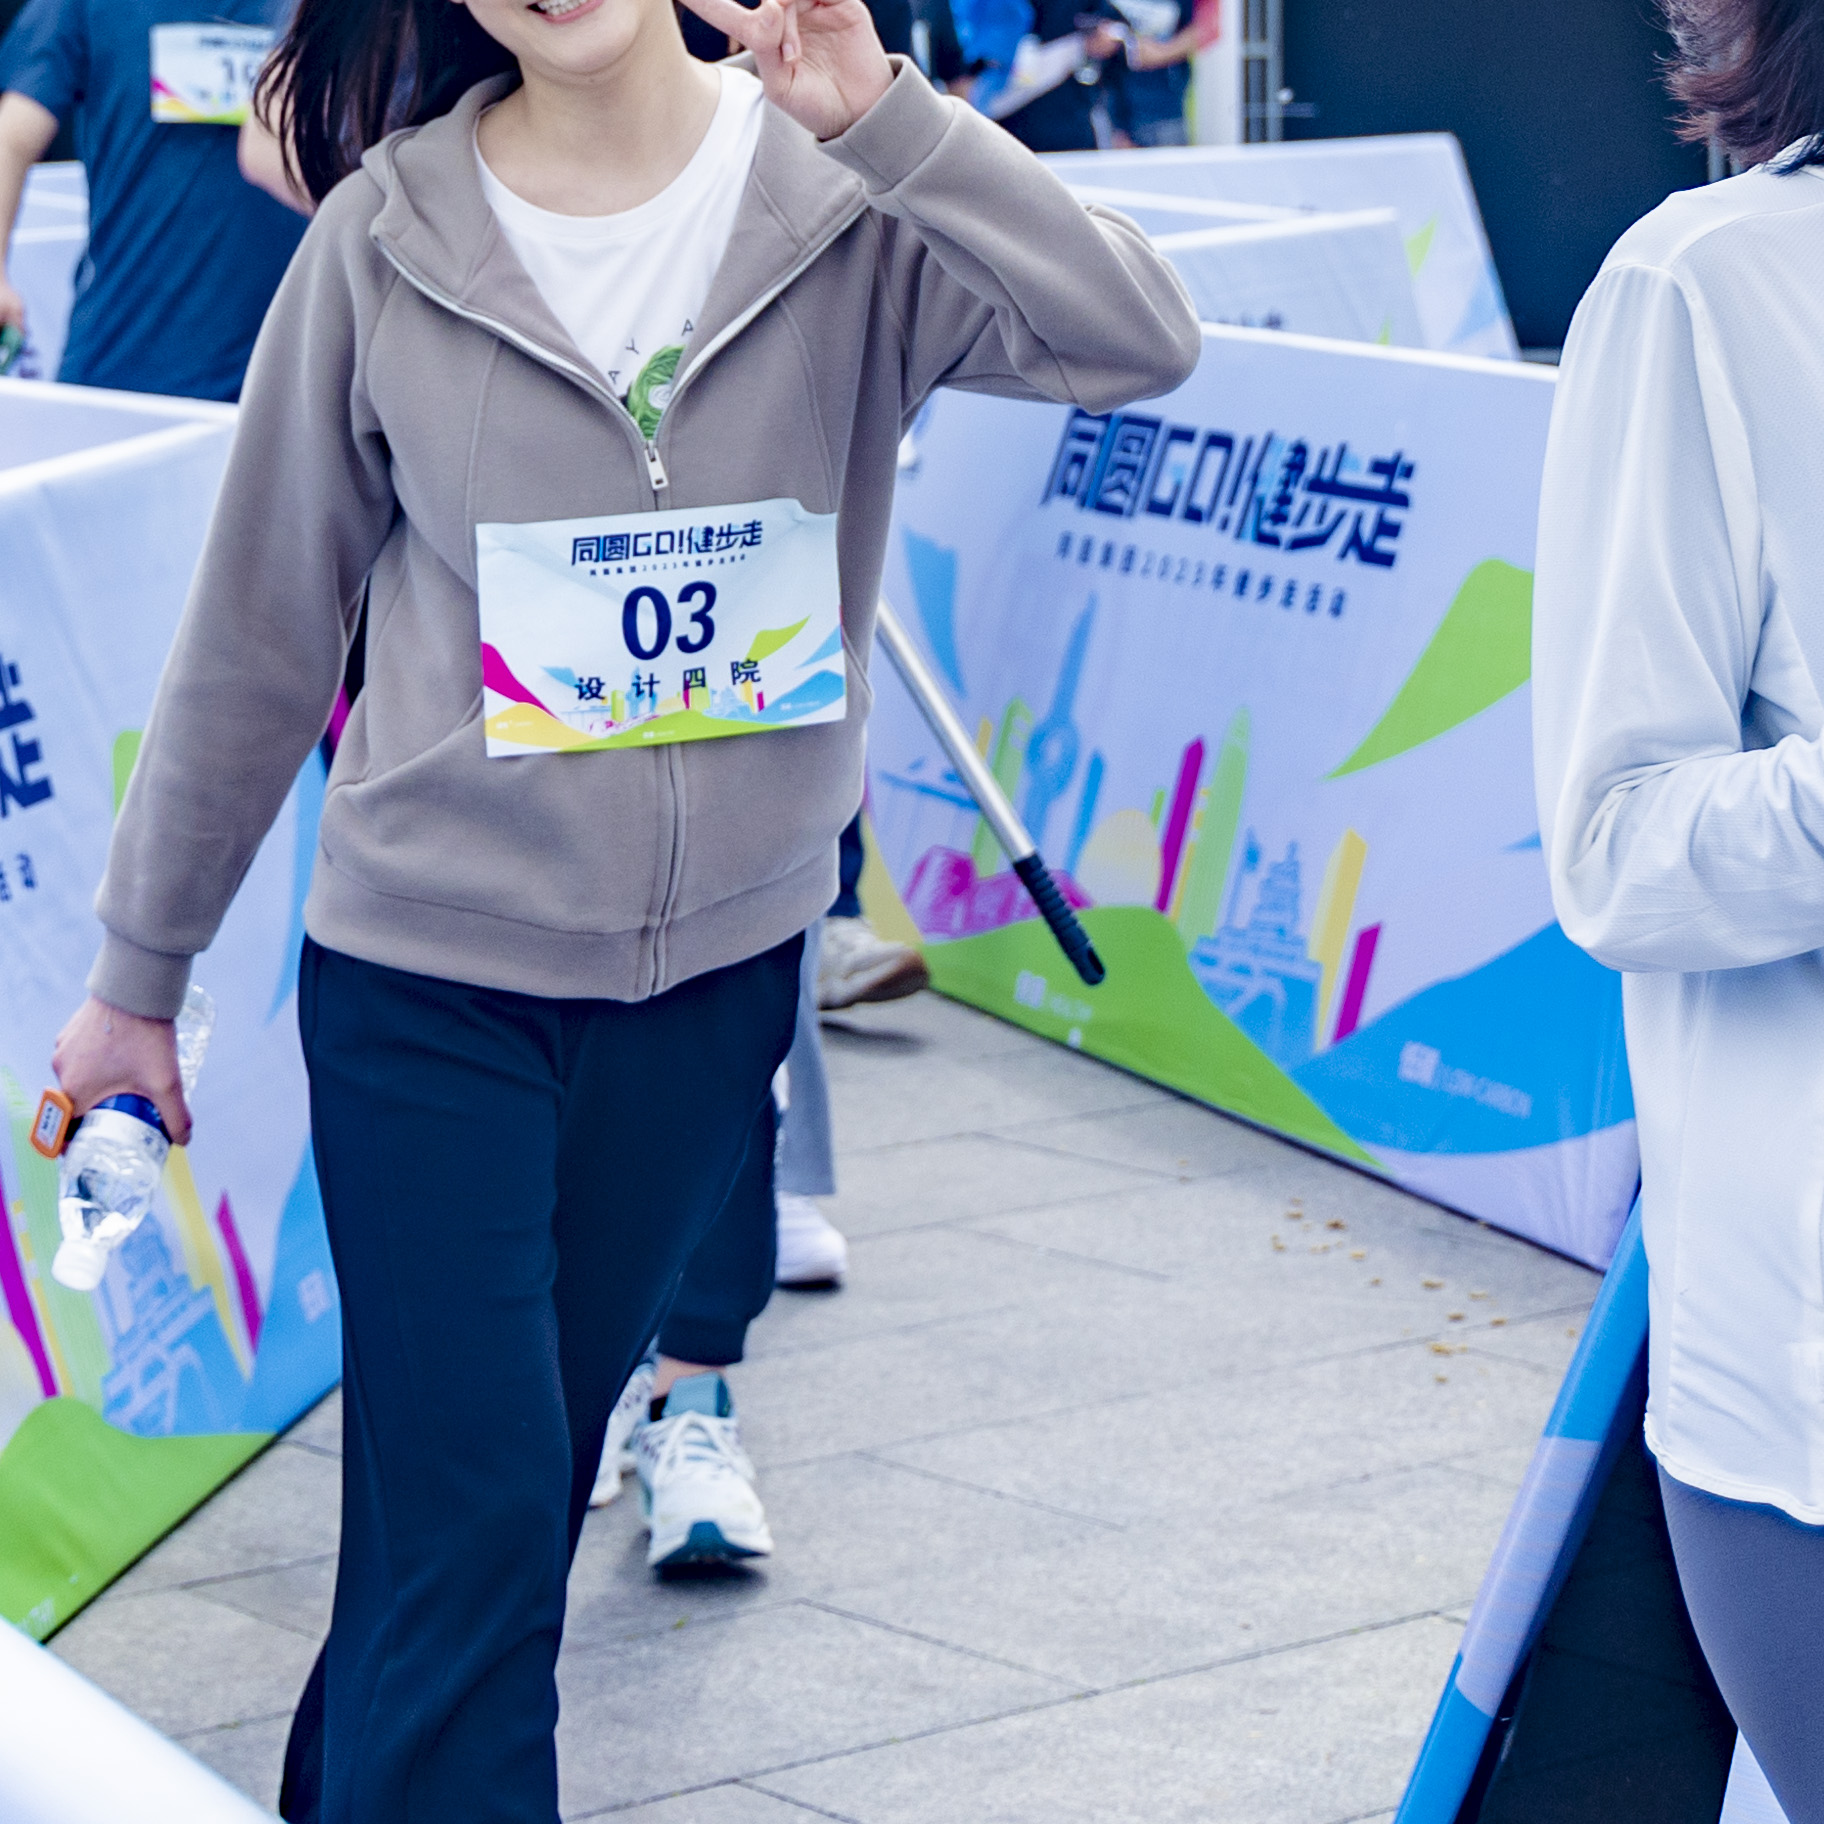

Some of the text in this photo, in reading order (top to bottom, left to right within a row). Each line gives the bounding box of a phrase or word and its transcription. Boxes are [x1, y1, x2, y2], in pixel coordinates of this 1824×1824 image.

[1039, 406, 1416, 569] 同圆GO!健步走
[571, 519, 763, 566] 同圆GO!健步走
[622, 581, 717, 660] 03
[576, 660, 761, 701] 设计四院
